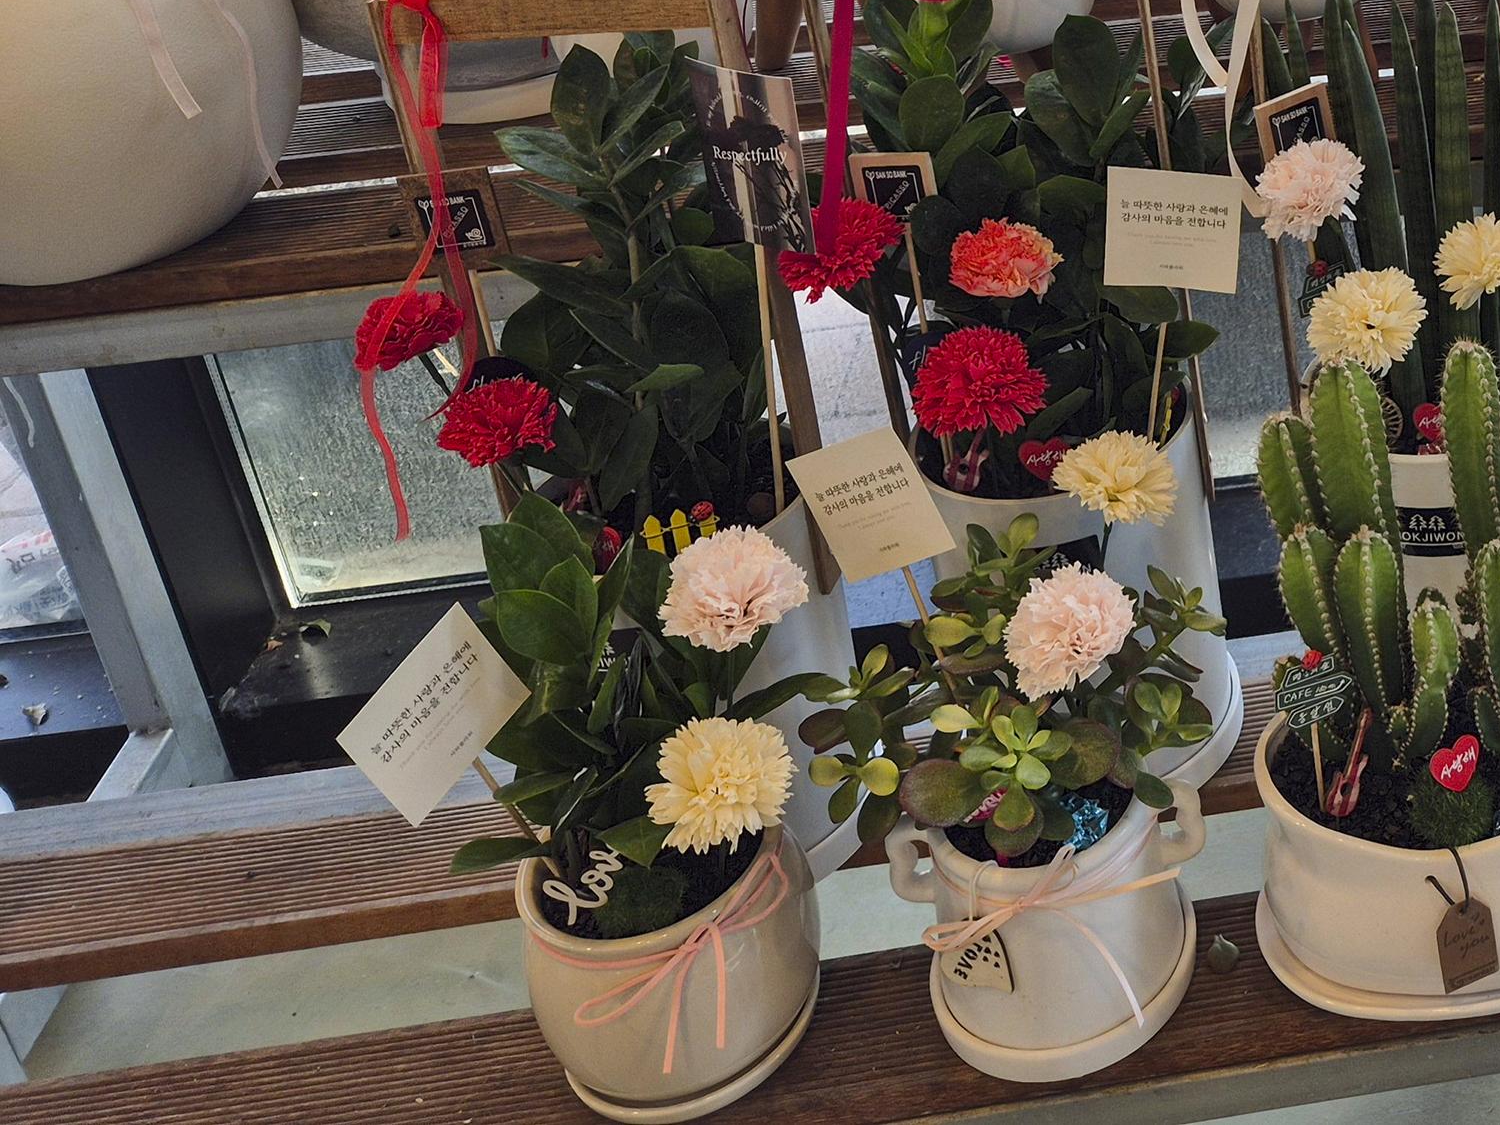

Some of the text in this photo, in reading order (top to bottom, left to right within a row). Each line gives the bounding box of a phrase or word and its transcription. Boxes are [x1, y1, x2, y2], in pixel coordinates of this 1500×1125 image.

[713, 146, 786, 166] Respectfully
[450, 196, 465, 206] BANK
[884, 180, 910, 210] PICASSO
[1120, 199, 1229, 216] 늘 따뜻한 사랑과 은혜에
[1122, 212, 1227, 229] 감사의 마음을 전합니다
[815, 462, 904, 502] 늘 따뜻한 사랑과 은혜에
[823, 477, 909, 516] 감사의 마음을 전합니다
[370, 640, 472, 754] 늘 따뜻한 사랑과 은혜에
[1284, 688, 1312, 704] CAFE
[380, 653, 478, 763] 감사의 마음을 전합니다
[1443, 926, 1475, 948] Love
[1460, 935, 1490, 959] you
